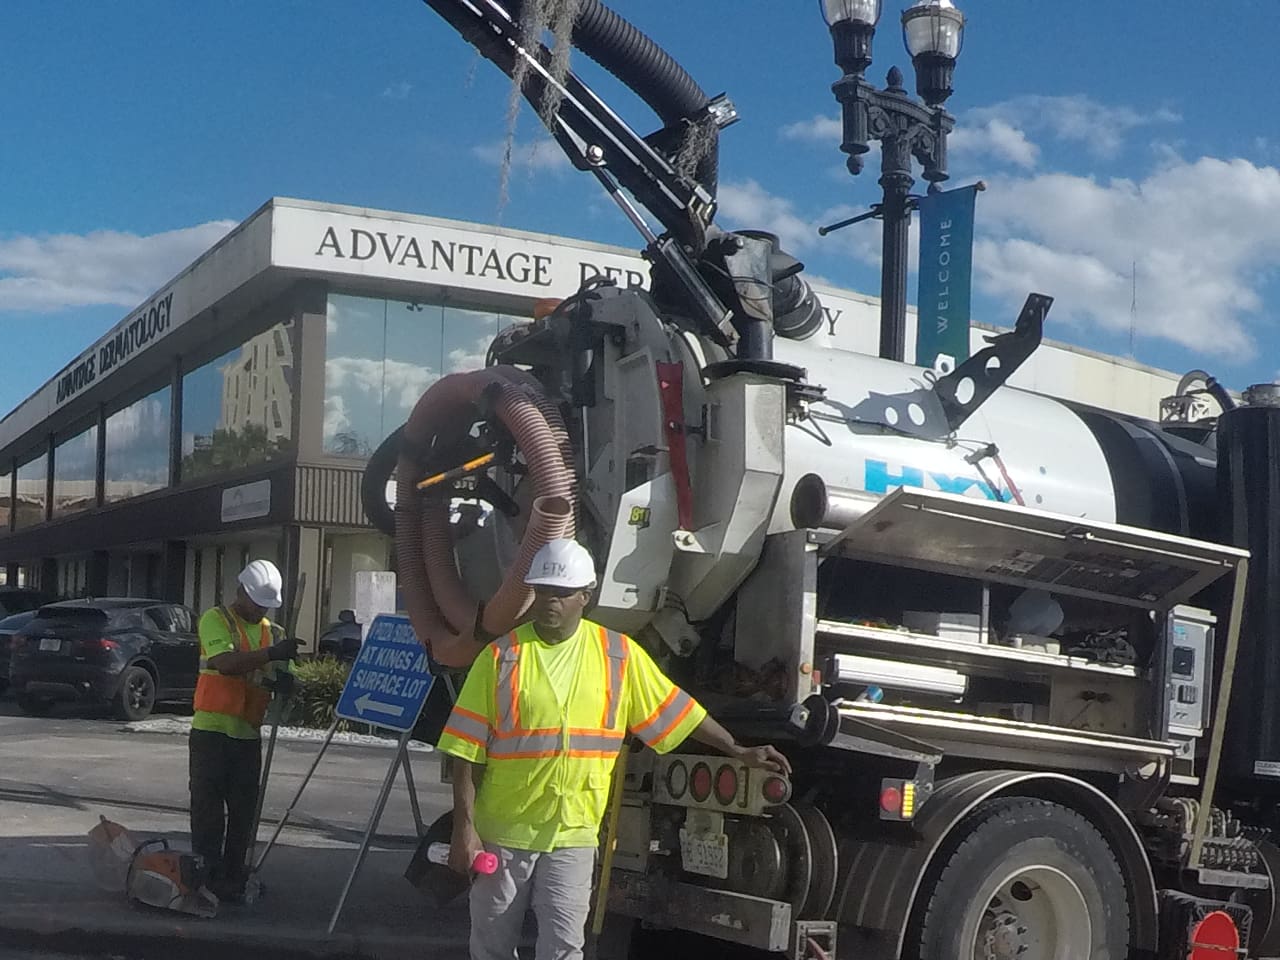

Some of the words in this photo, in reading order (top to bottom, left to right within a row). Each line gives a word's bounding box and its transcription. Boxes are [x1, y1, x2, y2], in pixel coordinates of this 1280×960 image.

[315, 226, 553, 287] ADVANTAGE
[937, 219, 953, 334] WELCOME
[99, 292, 174, 375] DERMATOLOGY
[354, 669, 403, 695] SURFACE
[402, 680, 426, 699] LOT
[361, 646, 378, 663] AT
[376, 648, 414, 671] KINGS
